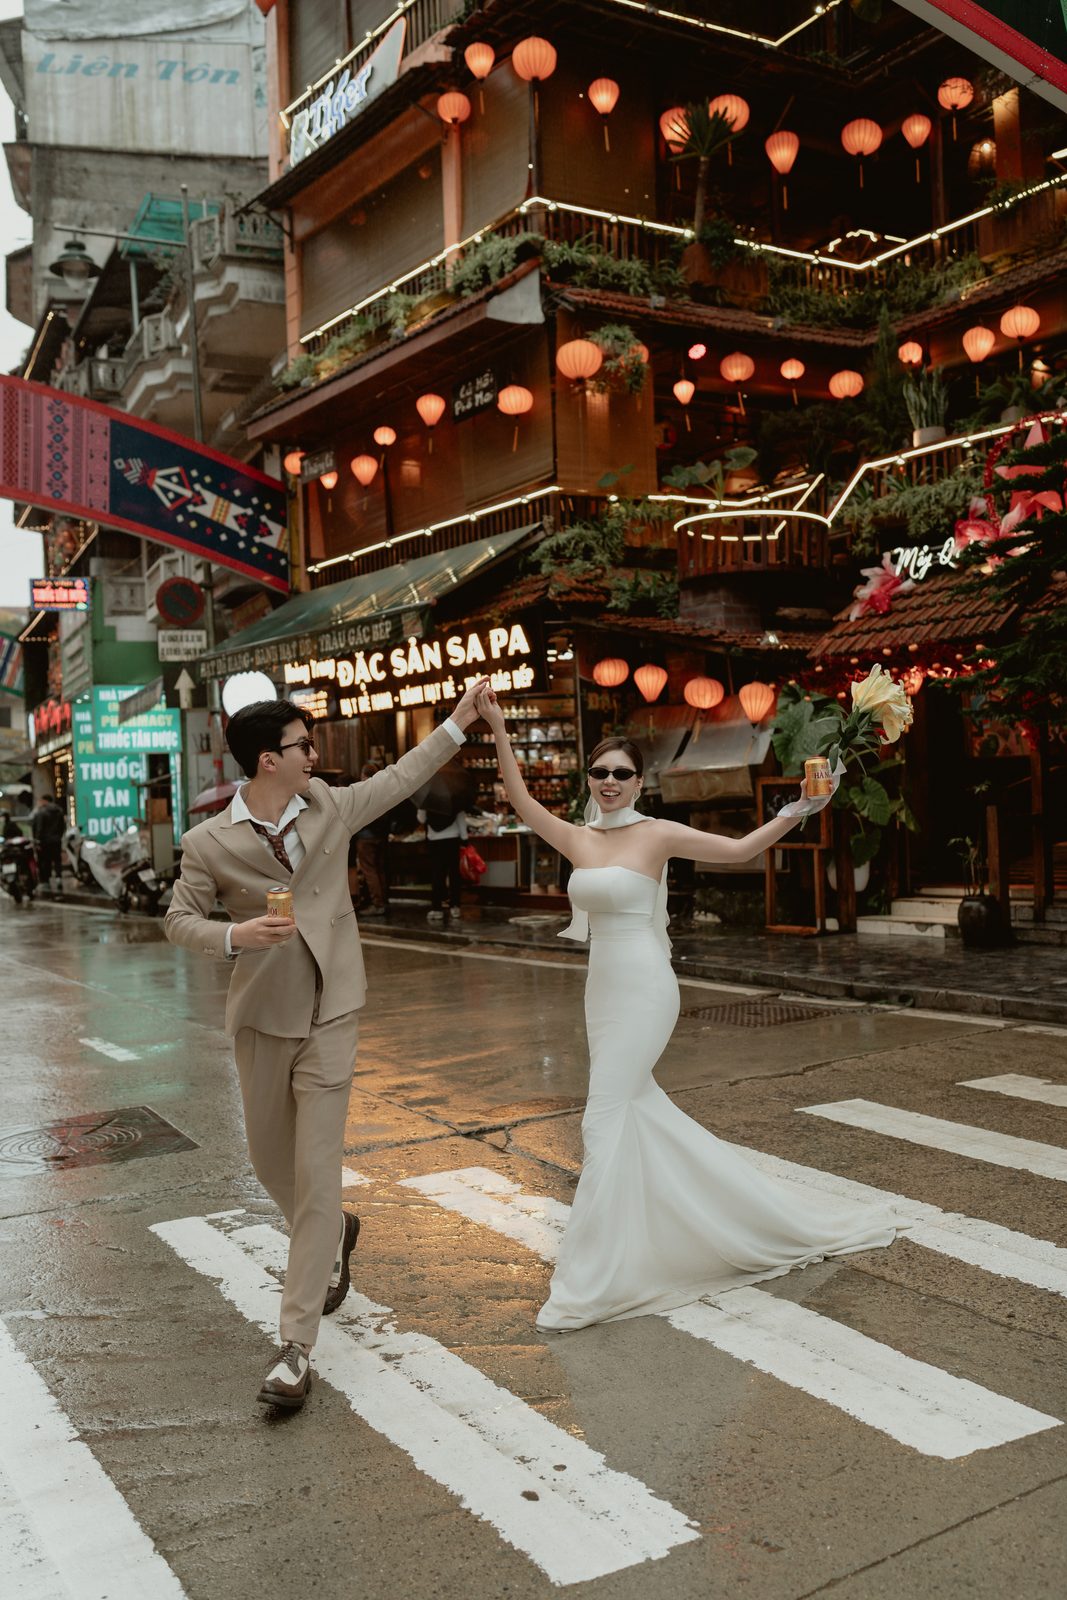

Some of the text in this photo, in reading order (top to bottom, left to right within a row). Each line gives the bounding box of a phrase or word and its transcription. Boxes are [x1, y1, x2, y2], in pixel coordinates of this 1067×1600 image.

[36, 53, 240, 84] Liên Tôn
[336, 624, 531, 691] ĐẶC SẢN SA PA
[98, 727, 131, 749] THUỐC
[131, 729, 151, 748] TÂN
[152, 731, 178, 750] DƯỢC
[80, 756, 141, 781] THUỐC
[93, 786, 130, 808] TÂN
